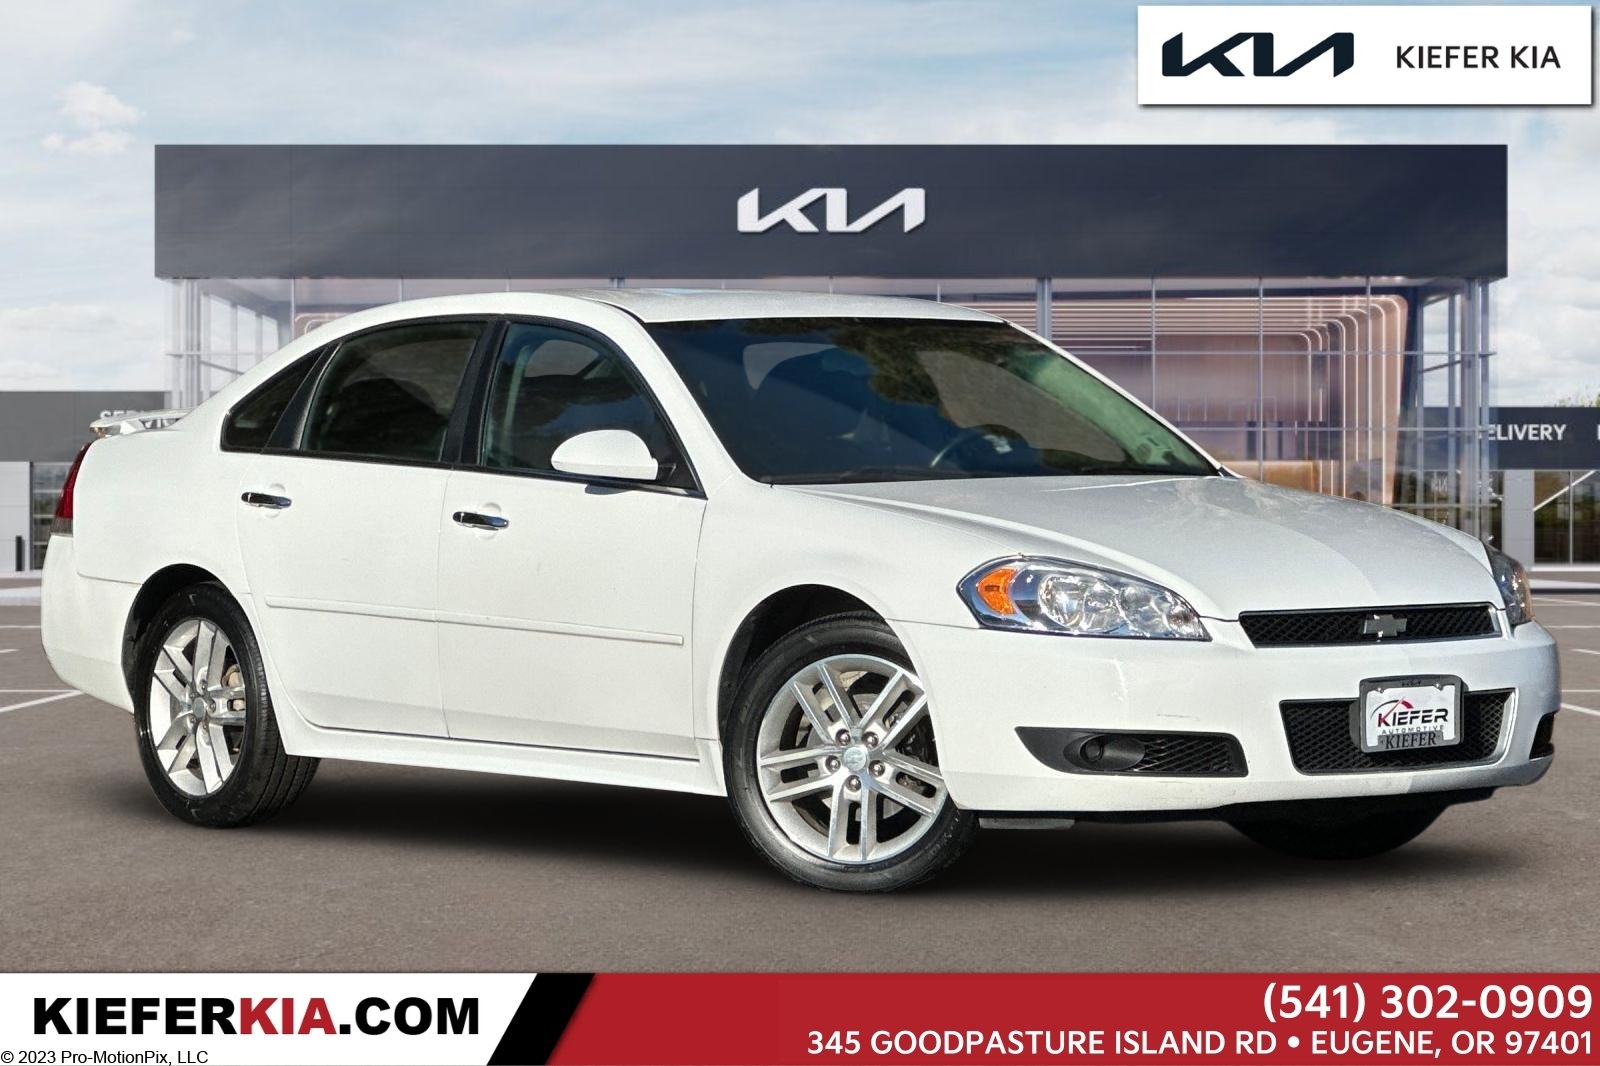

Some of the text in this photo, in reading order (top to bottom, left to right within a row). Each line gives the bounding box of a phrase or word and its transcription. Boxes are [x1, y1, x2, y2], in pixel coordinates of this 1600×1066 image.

[737, 187, 926, 233] KIA
[1480, 423, 1567, 441] ELIVERY
[1377, 708, 1449, 728] KIEFER
[1381, 724, 1444, 735] AUTOMOTIVE
[1384, 731, 1437, 750] KIEFER
